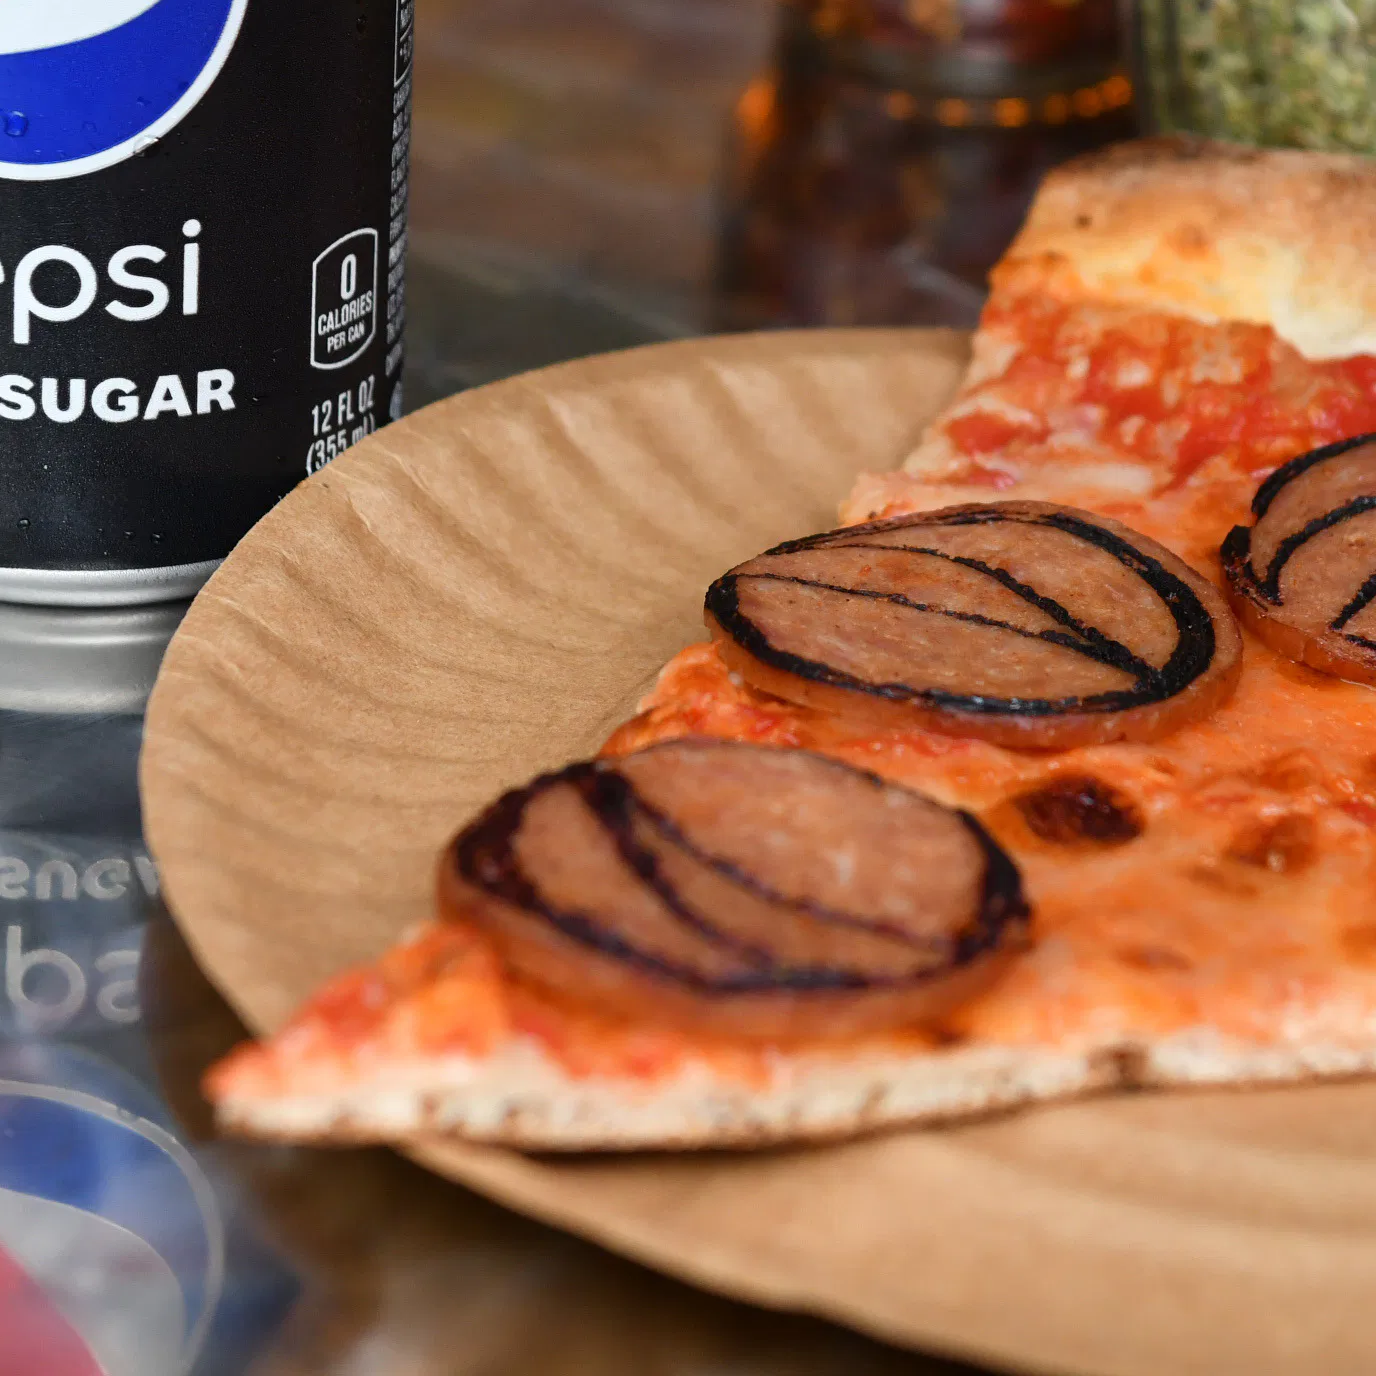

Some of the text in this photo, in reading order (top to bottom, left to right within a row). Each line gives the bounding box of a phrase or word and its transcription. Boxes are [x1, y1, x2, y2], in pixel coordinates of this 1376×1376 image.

[340, 253, 357, 300] 0
[317, 290, 373, 336] CALORIES
[327, 320, 365, 353] PER CAN
[311, 374, 375, 436] 12 FL OZ
